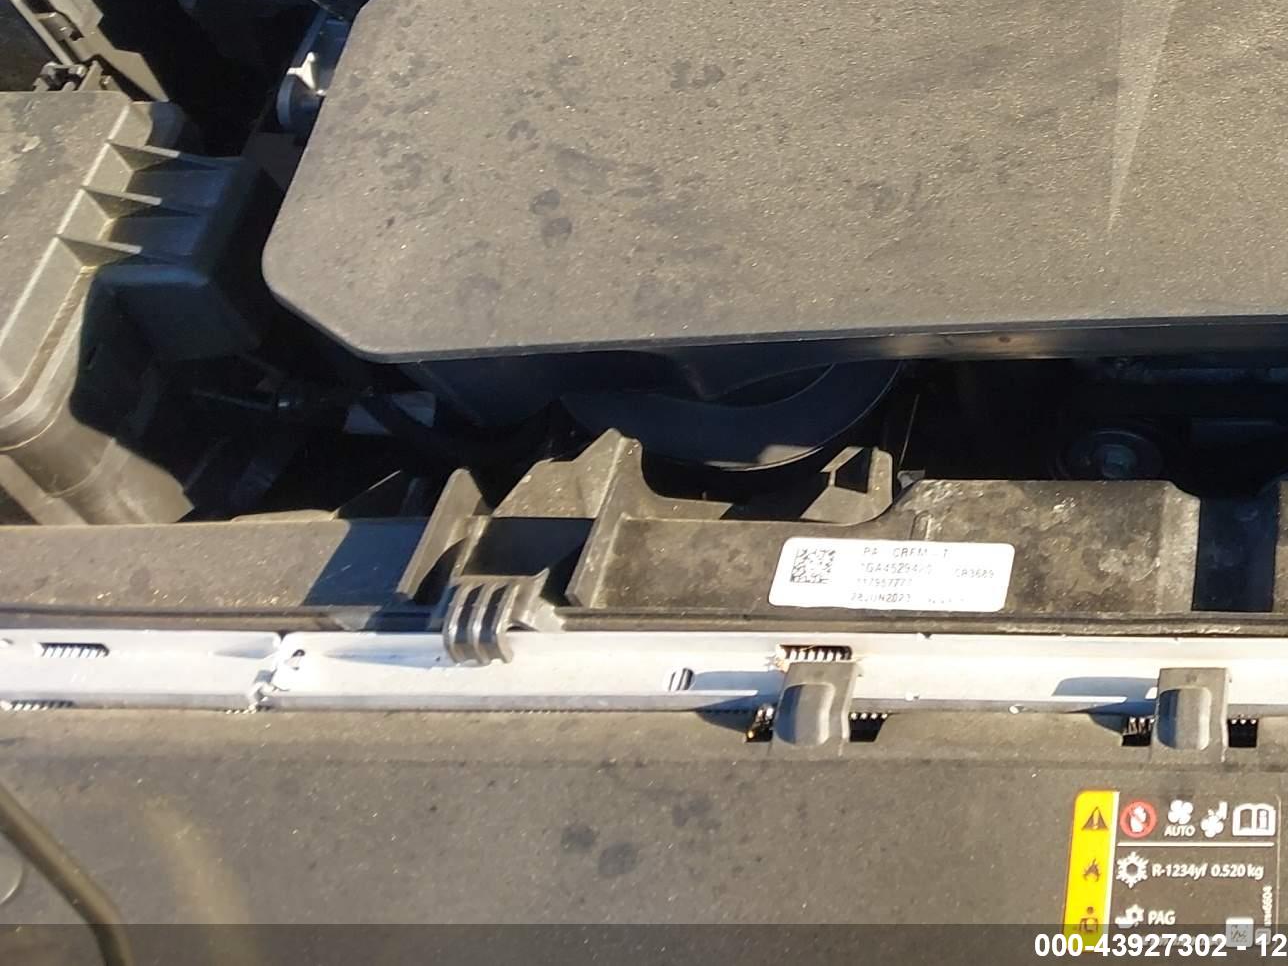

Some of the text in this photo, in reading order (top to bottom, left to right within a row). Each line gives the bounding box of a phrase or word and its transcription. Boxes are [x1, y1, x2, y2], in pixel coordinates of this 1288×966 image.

[1164, 824, 1196, 837] AUTO
[1151, 863, 1265, 882] R-1234yf 0.520 kg
[1148, 910, 1177, 926] PAG
